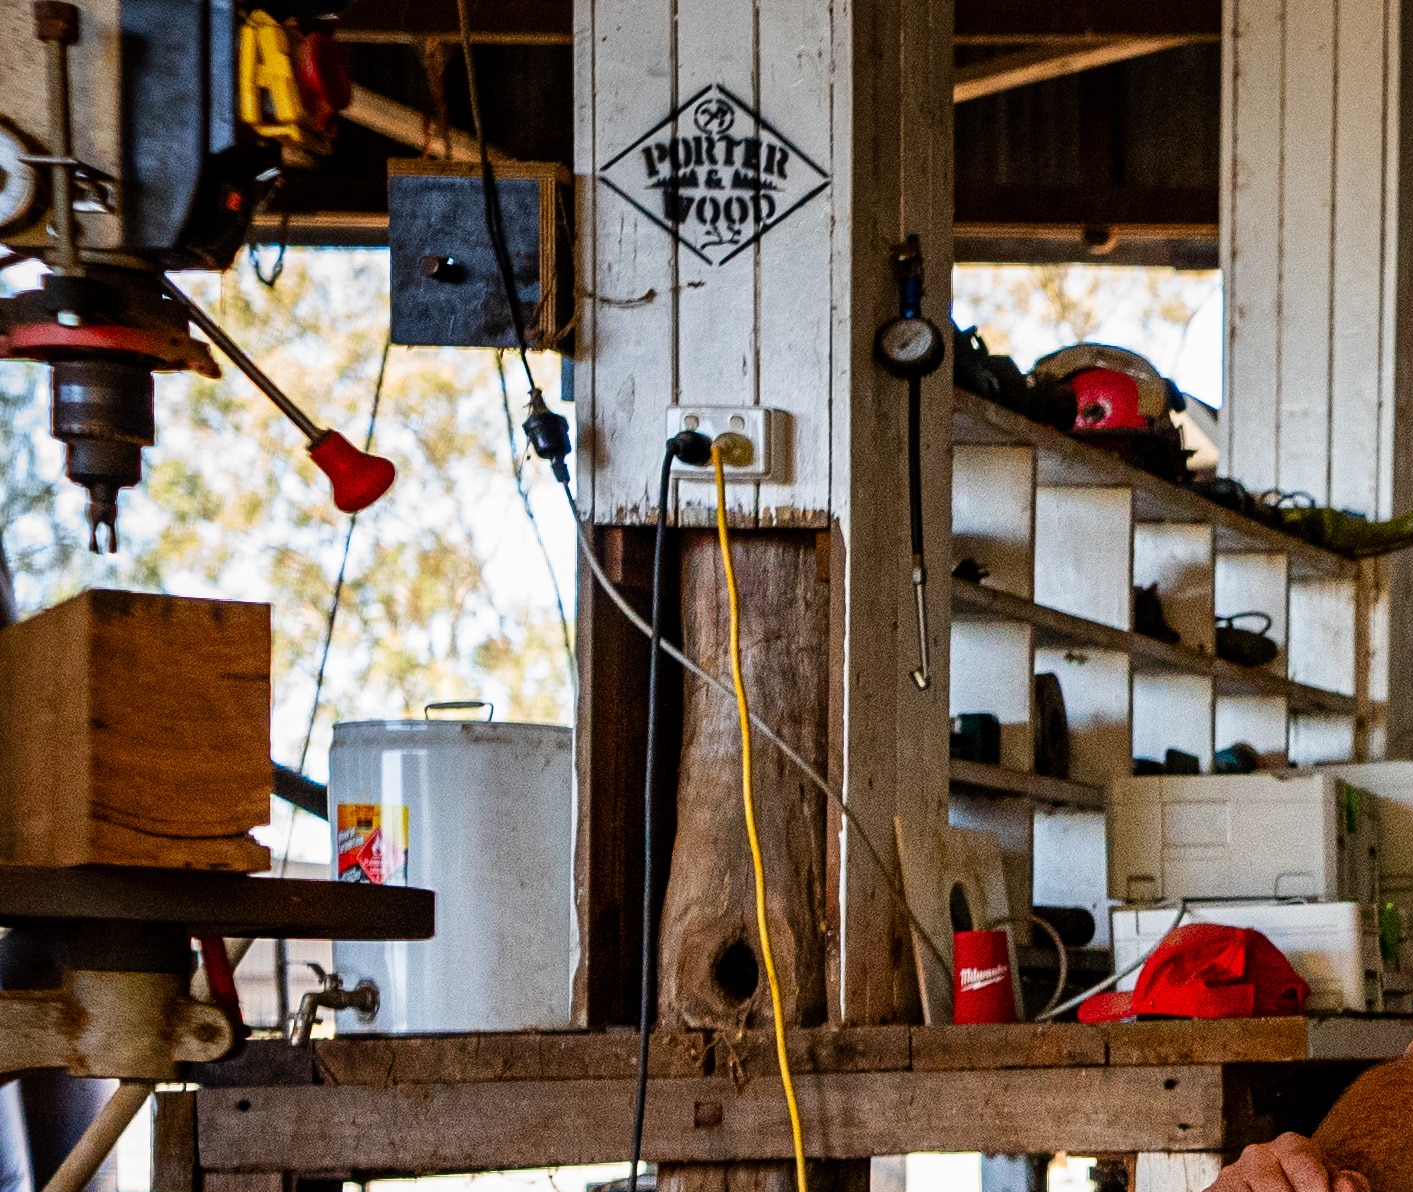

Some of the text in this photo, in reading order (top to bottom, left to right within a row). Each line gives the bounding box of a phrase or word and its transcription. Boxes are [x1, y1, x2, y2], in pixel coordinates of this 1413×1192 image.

[640, 134, 790, 179] PORTER
[704, 169, 726, 190] &
[663, 188, 776, 227] WOOD
